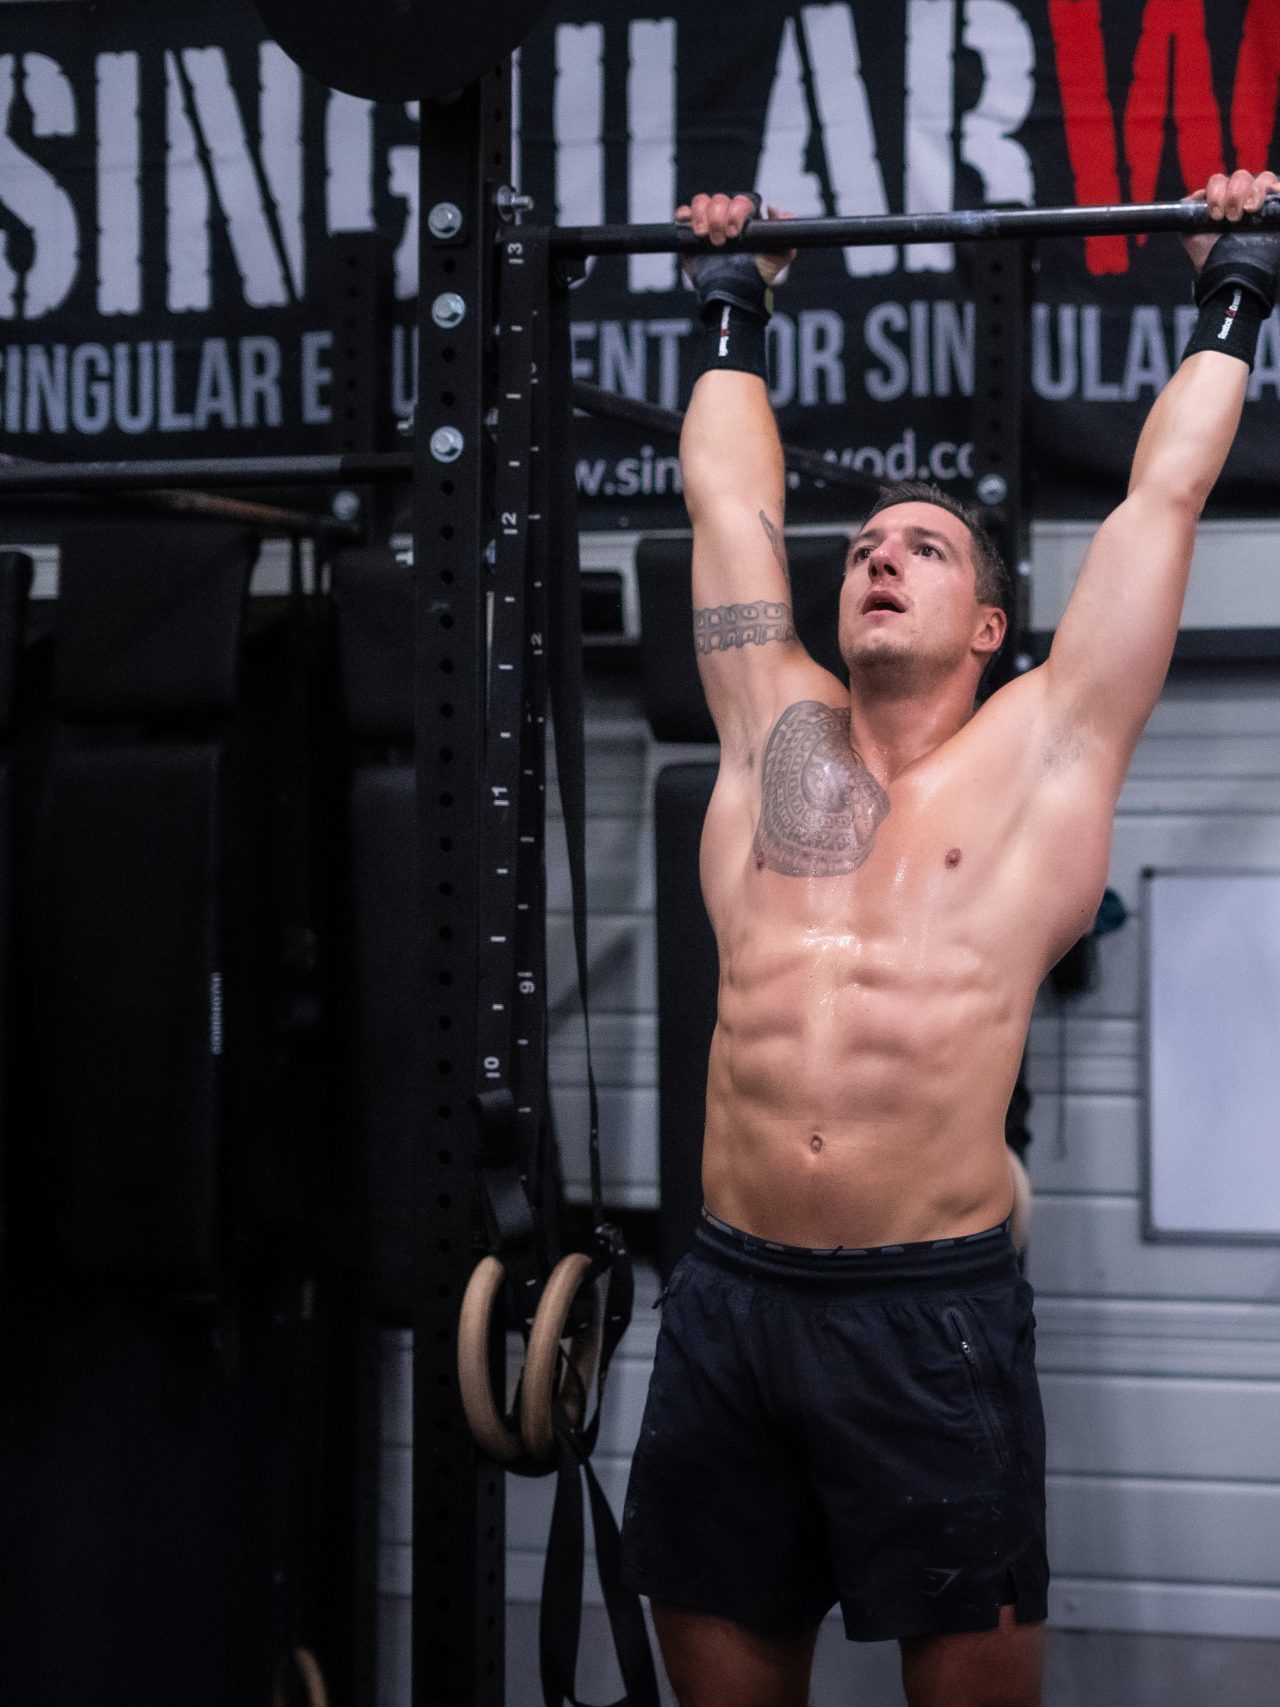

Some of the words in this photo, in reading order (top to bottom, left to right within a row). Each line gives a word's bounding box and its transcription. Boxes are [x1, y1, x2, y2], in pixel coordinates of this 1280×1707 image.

[0, 335, 284, 434] INGULAR
[765, 308, 847, 408] OR
[863, 301, 1200, 401] SINULA
